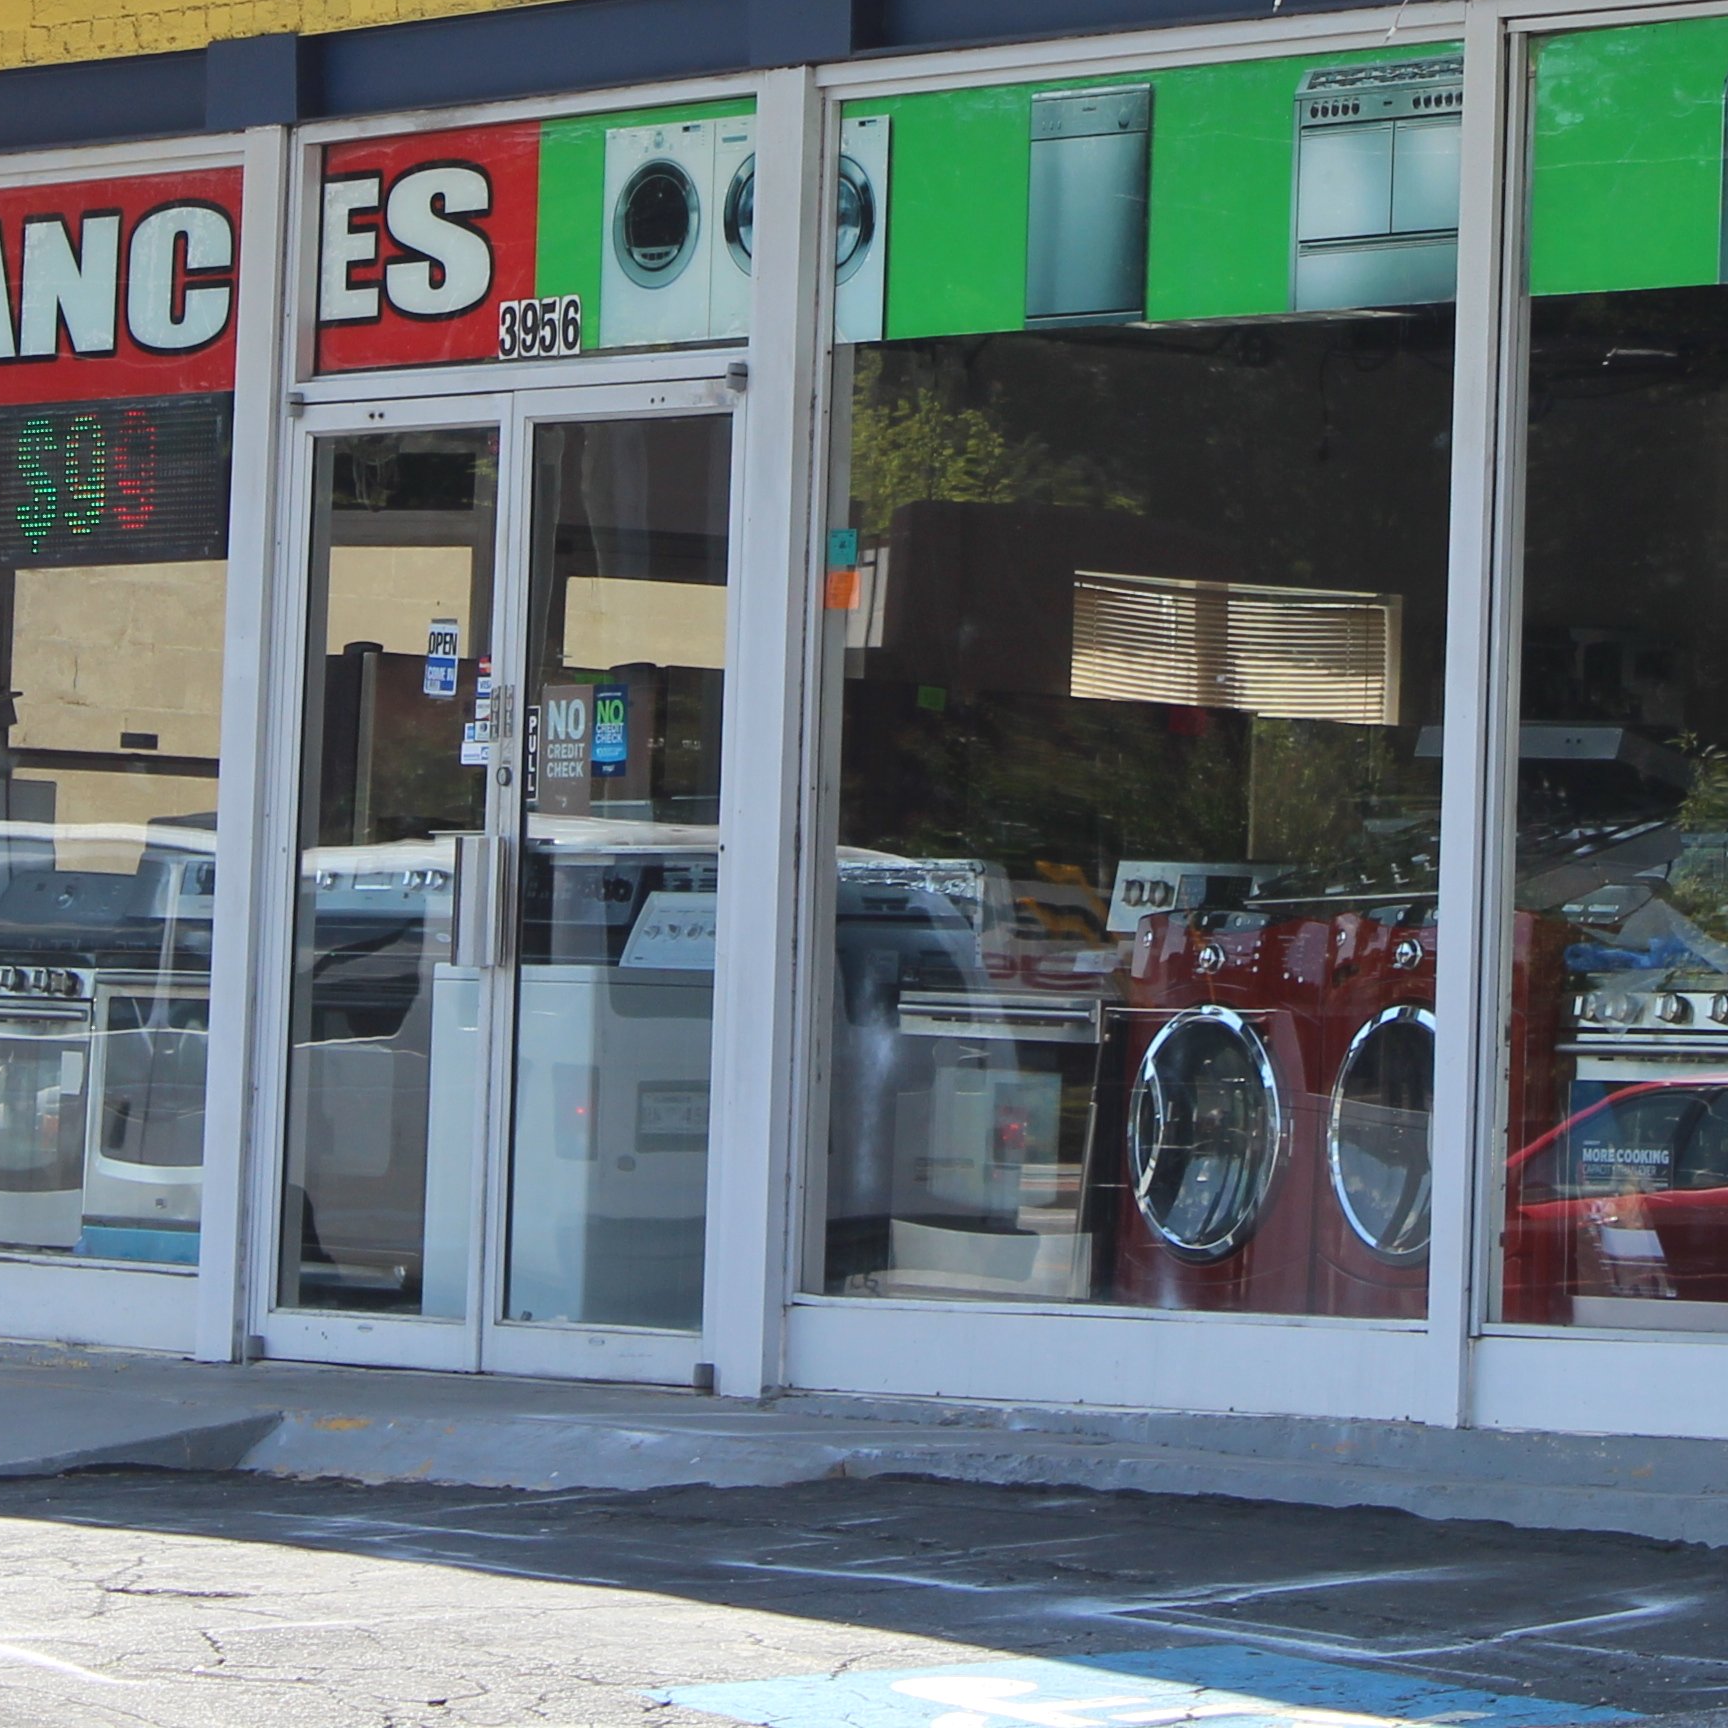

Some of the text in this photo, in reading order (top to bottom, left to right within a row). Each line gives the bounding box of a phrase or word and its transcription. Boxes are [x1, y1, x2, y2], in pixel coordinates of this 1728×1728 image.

[499, 298, 581, 357] 3956
[428, 631, 457, 656] OPEN
[547, 698, 586, 740] NO
[597, 699, 624, 724] NO
[595, 733, 623, 744] CHECK
[596, 722, 624, 734] CREDIT
[528, 715, 537, 792] PULL
[547, 743, 585, 760] CREDIT
[546, 761, 584, 778] CHECK
[1582, 1148, 1670, 1165] MORE COOKING
